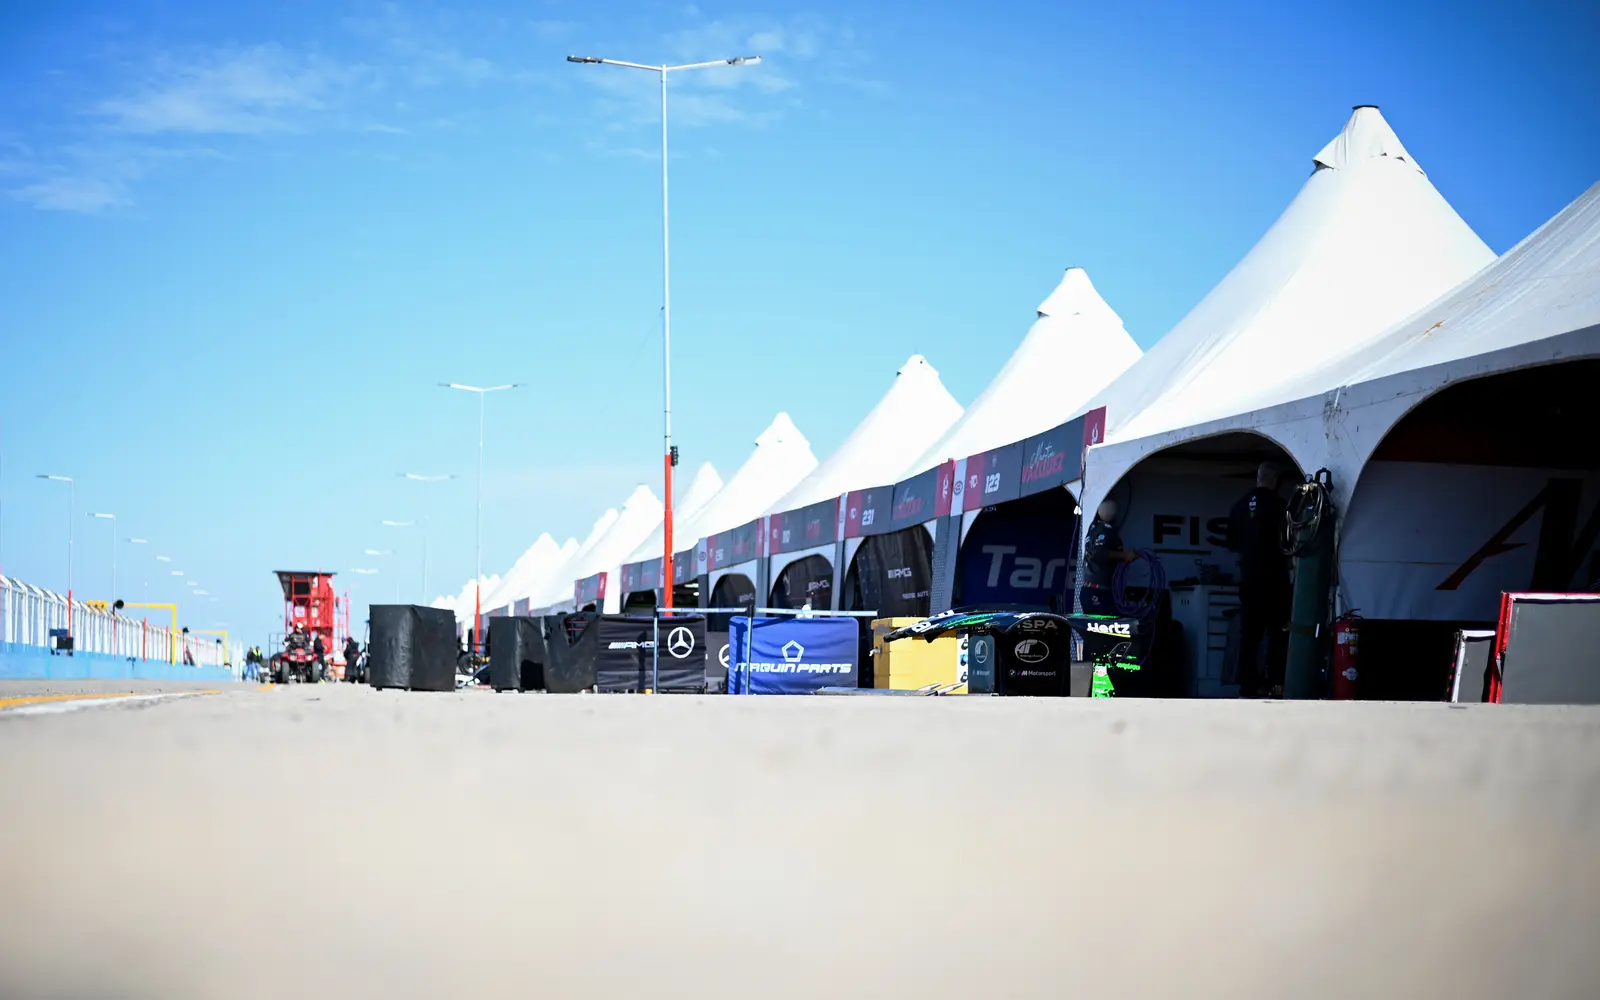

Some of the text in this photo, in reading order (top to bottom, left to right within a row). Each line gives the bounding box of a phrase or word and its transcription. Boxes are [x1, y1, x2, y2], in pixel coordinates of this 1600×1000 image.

[985, 472, 1001, 494] 123
[1087, 622, 1130, 635] Hertz
[622, 641, 655, 649] AMG
[796, 663, 853, 674] PARTS
